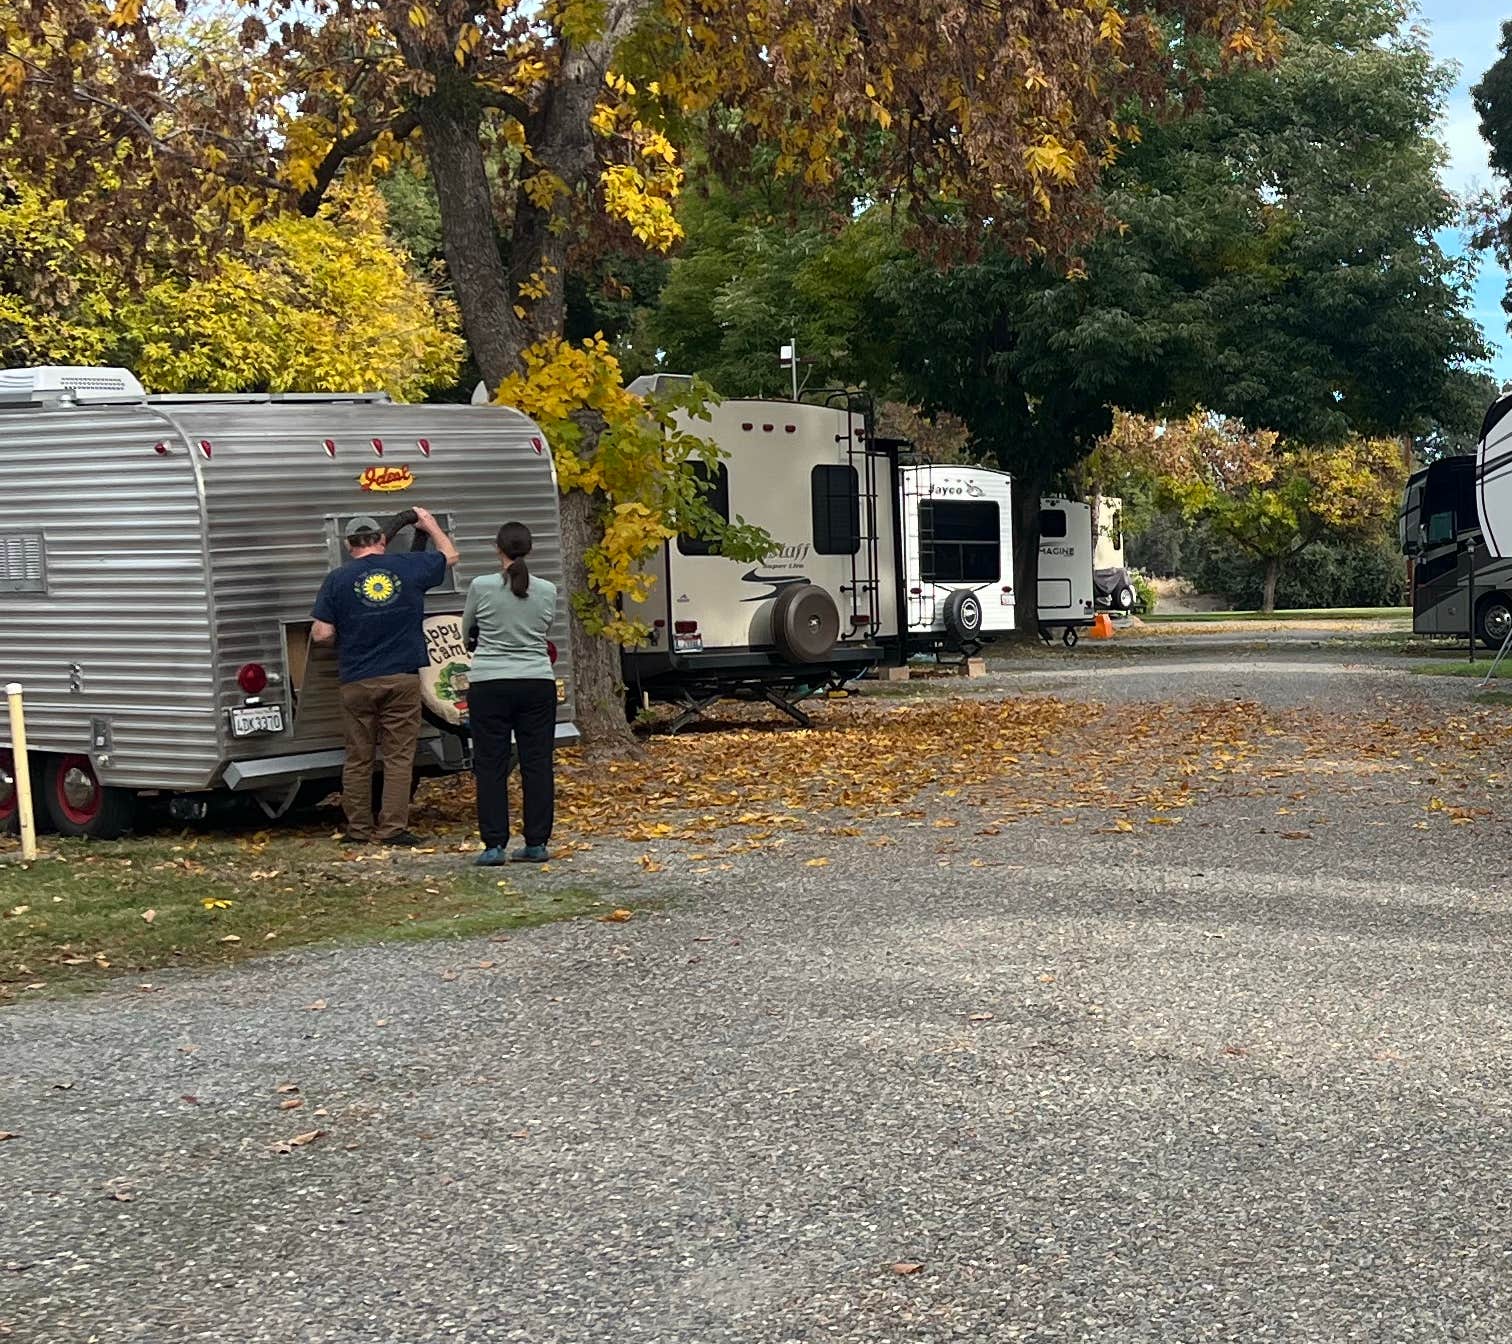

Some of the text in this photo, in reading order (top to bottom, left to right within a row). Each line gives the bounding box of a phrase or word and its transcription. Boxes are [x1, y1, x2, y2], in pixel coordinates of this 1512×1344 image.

[1039, 547, 1074, 556] MAGINE
[423, 622, 462, 647] appy
[428, 644, 472, 664] Cam
